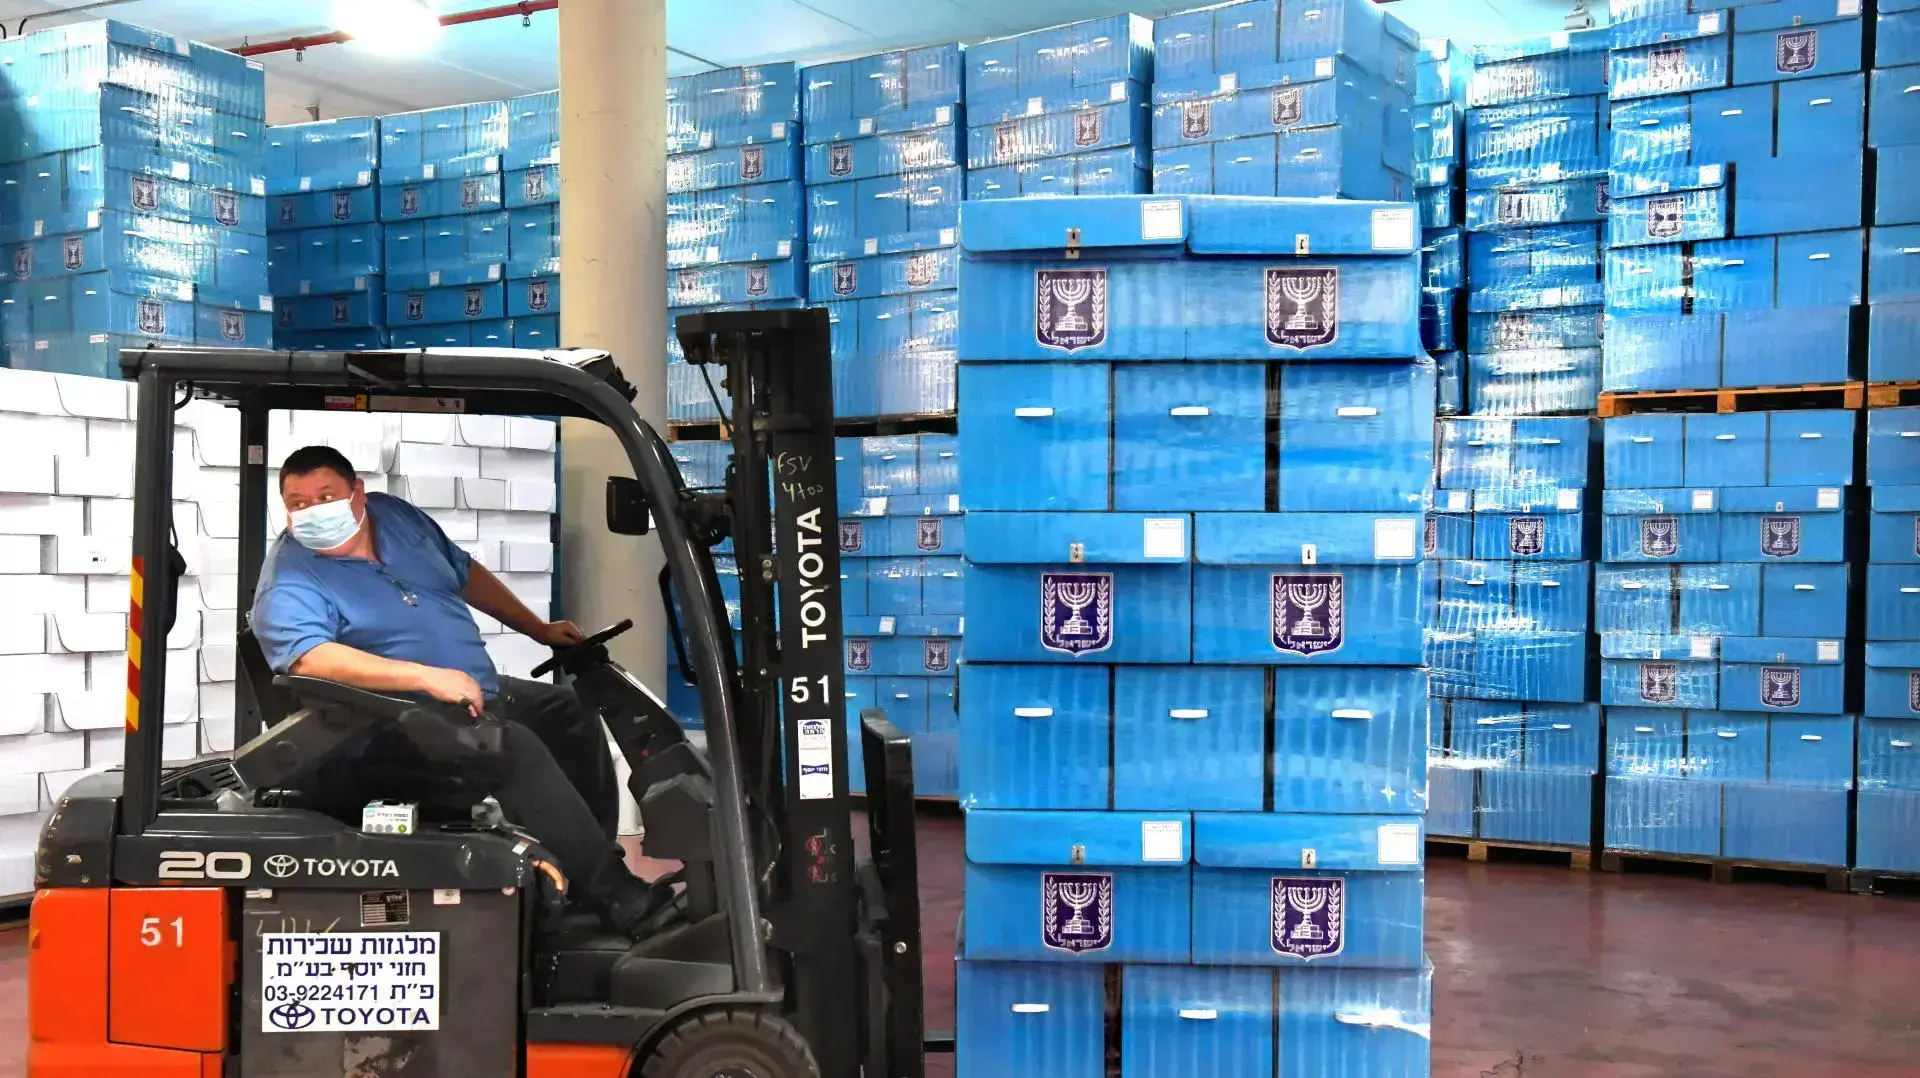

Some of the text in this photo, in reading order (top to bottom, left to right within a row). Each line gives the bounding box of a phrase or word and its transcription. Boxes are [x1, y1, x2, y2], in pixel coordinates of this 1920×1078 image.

[1051, 331, 1092, 344] ישראל
[1280, 330, 1322, 344] ישראל
[796, 507, 827, 649] TOYOTA
[1056, 634, 1096, 648] ישראל
[1287, 636, 1328, 649] ישראל
[790, 675, 830, 705] 51
[159, 851, 252, 880] 20
[304, 858, 400, 877] TOYOTA
[141, 916, 183, 947] 51
[267, 935, 436, 955] מלגזות שכירות
[1058, 934, 1098, 947] ישראל
[1286, 939, 1327, 952] ישראל
[340, 962, 383, 980] יוסף
[389, 962, 426, 976] חזני
[264, 985, 378, 1001] 03-9224171
[320, 1008, 430, 1025] TOYOTA
